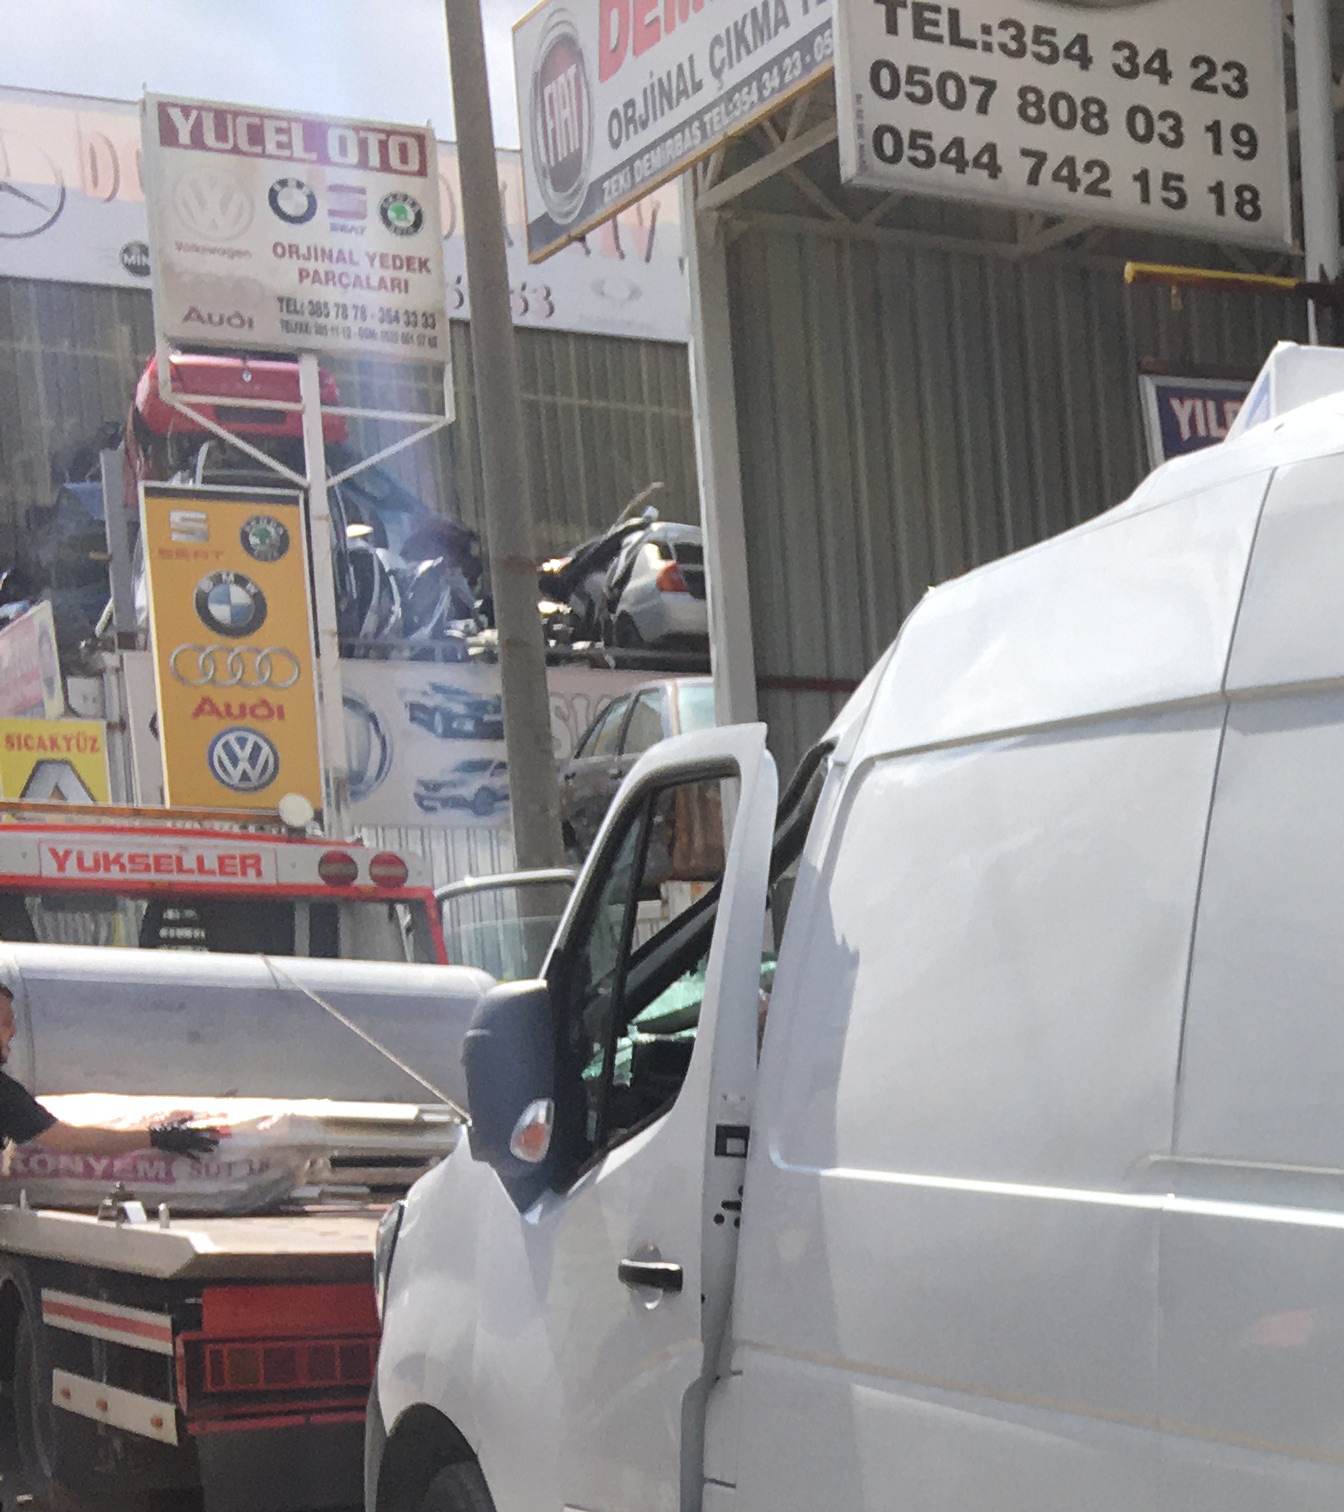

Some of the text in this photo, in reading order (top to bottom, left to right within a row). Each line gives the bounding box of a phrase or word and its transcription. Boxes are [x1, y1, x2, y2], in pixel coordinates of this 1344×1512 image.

[873, 0, 1250, 100] TEL:354 34 23
[326, 125, 421, 174] OTO
[544, 63, 581, 168] FIAT
[869, 59, 1259, 161] 0507 808 03 19
[872, 124, 1003, 181] 0544
[1019, 148, 1112, 198] 742
[1132, 167, 1189, 210] 15
[1207, 180, 1263, 223] 18
[366, 251, 431, 275] YEDEK
[48, 846, 263, 878] YUKSELLER
